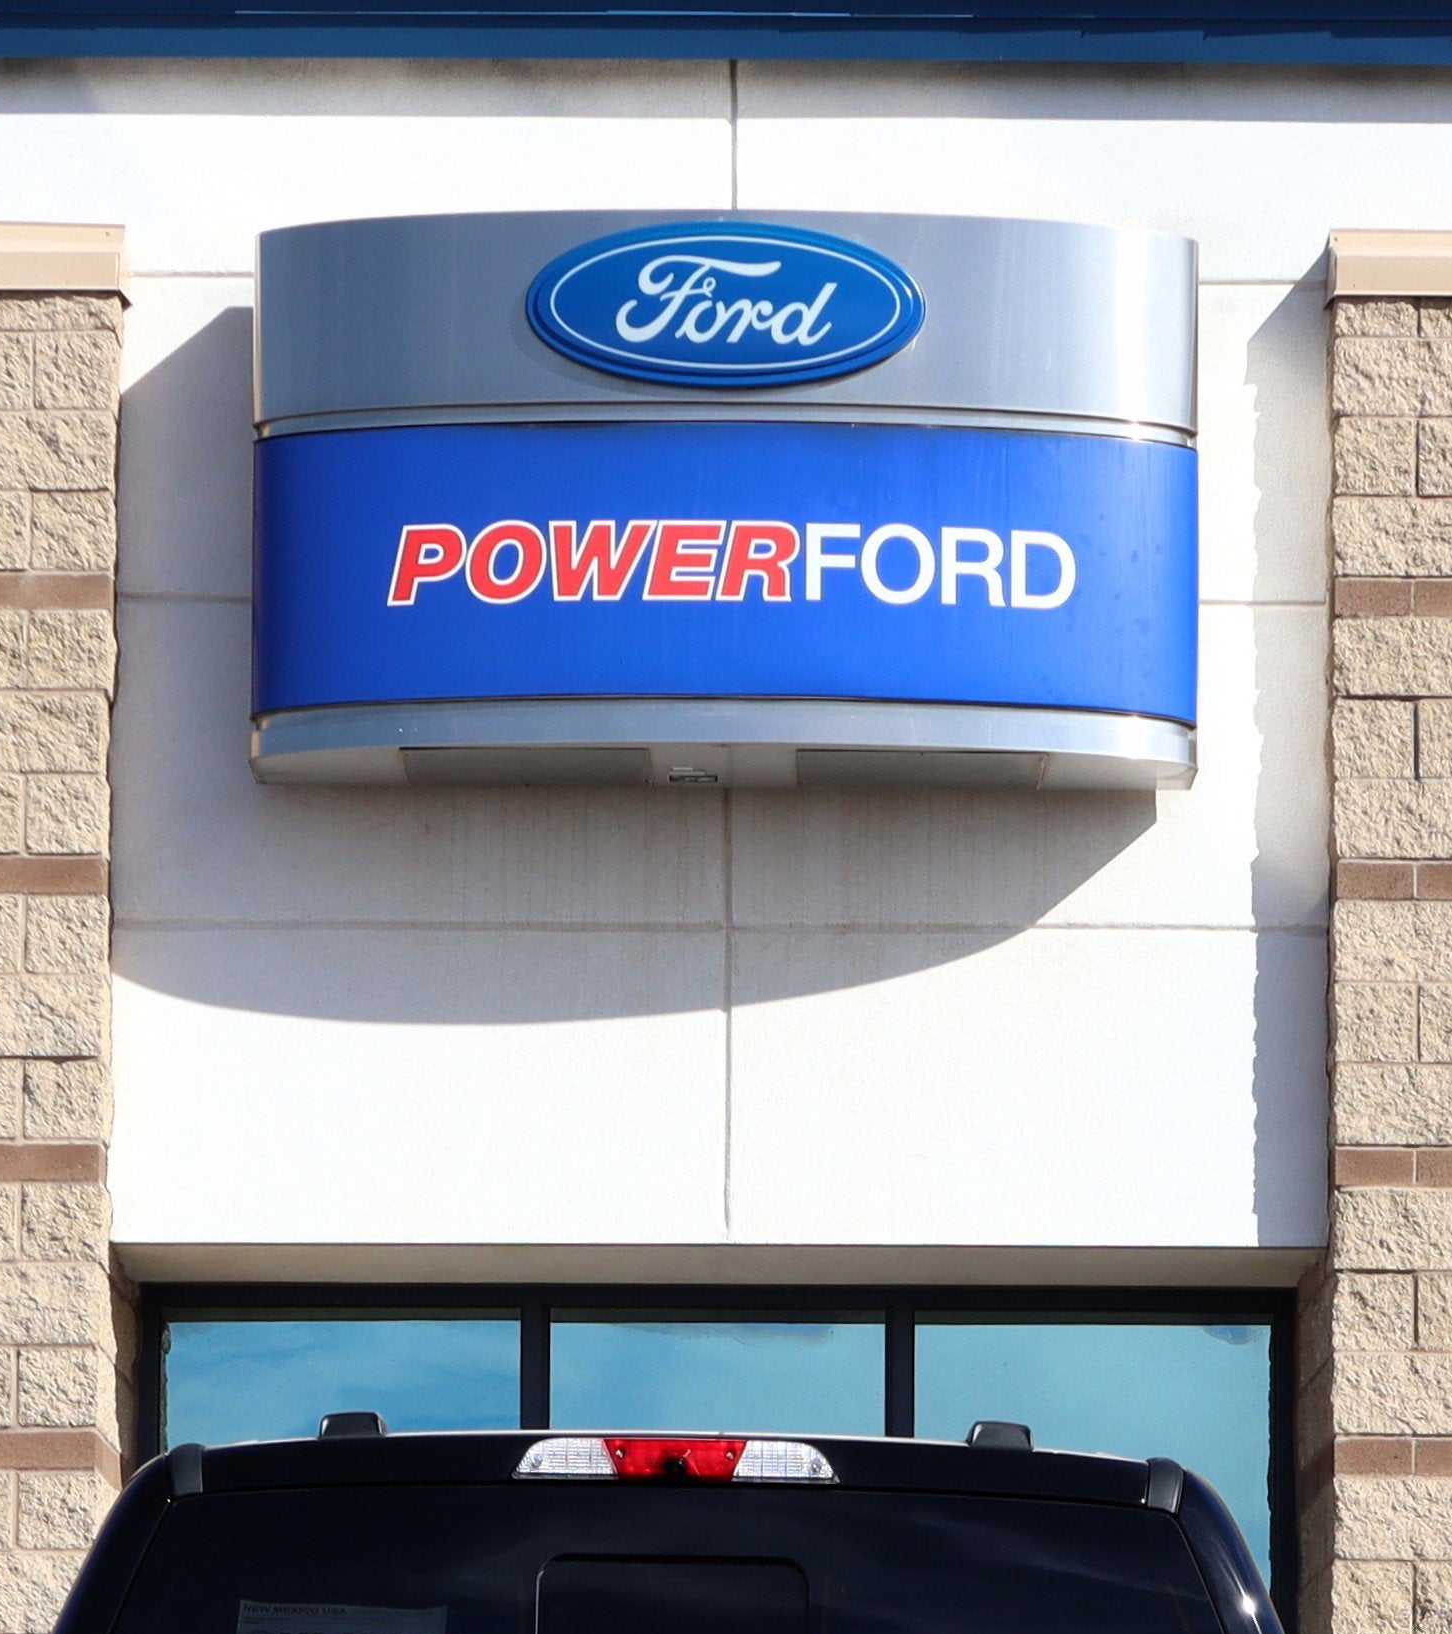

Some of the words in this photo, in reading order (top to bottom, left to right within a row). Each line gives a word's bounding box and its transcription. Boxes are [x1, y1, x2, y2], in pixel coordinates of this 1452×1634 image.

[616, 254, 838, 346] Ford
[386, 519, 1076, 611] POWERFORD
[243, 1603, 271, 1614] NEW
[273, 1604, 320, 1615] MEXICO
[322, 1605, 348, 1615] USA
